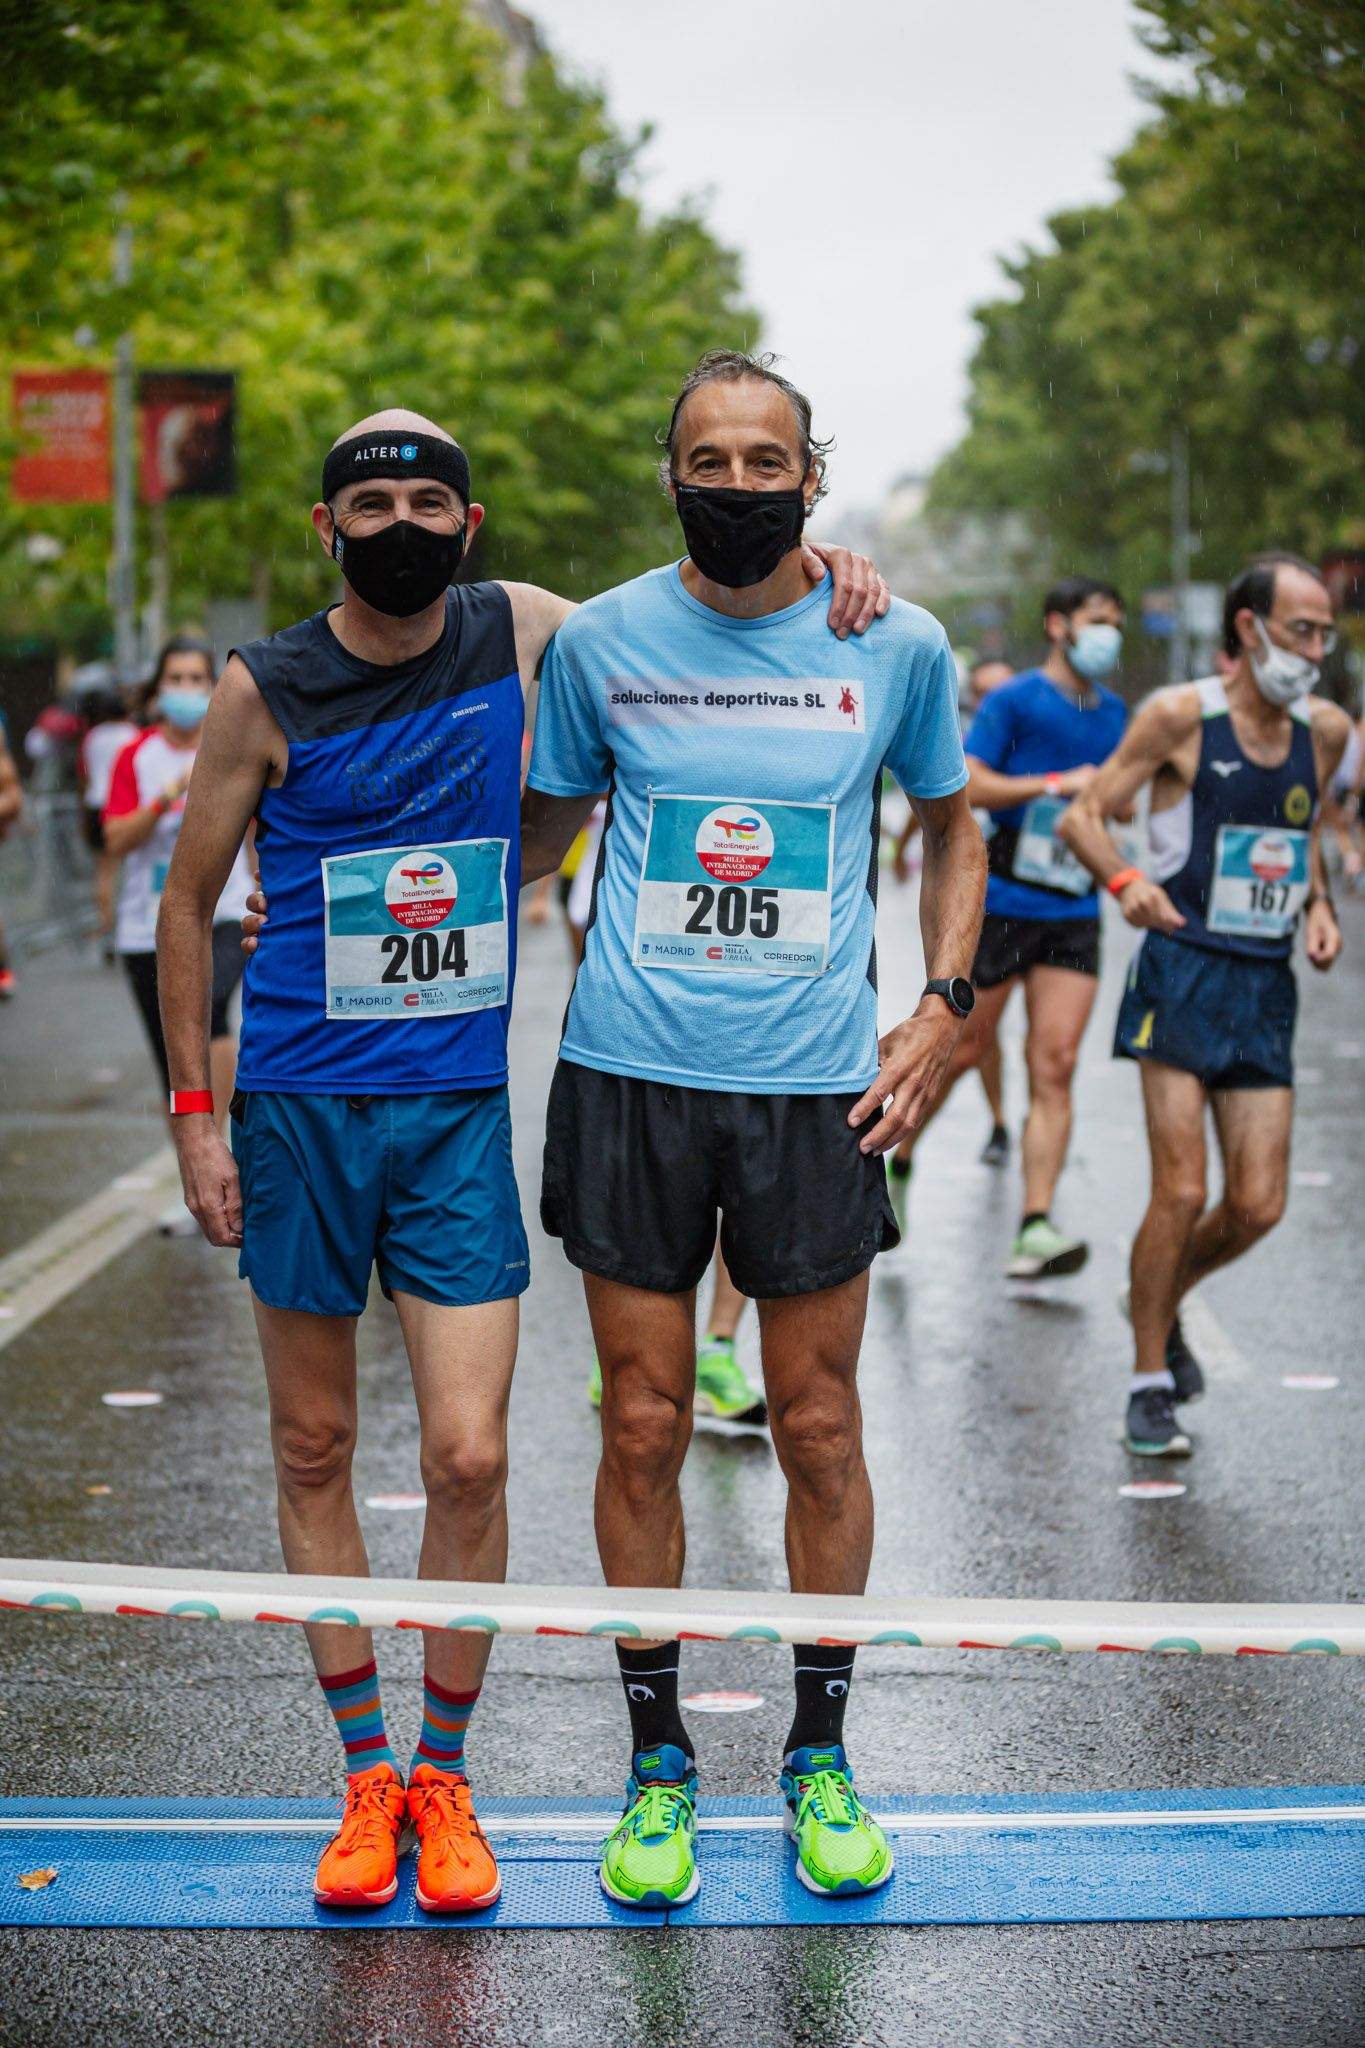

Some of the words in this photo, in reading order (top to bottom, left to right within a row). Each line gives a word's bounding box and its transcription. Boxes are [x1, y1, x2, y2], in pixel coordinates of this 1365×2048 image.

[611, 690, 699, 705] soluciones
[704, 691, 799, 709] deportivas
[804, 693, 825, 708] SL
[452, 702, 490, 719] patagonia
[713, 842, 760, 851] TotalEnergies
[725, 869, 753, 877] MADRID
[401, 888, 445, 898] TotalEnergies
[1250, 881, 1290, 914] 167
[412, 902, 432, 910] MILLA
[684, 884, 780, 939] 205
[405, 917, 415, 925] DE
[415, 915, 441, 923] MADRID
[655, 945, 695, 956] MADRID
[724, 947, 749, 955] MILLA
[380, 928, 468, 984] 204
[421, 991, 444, 999] MILLA
[350, 996, 393, 1007] MADRID
